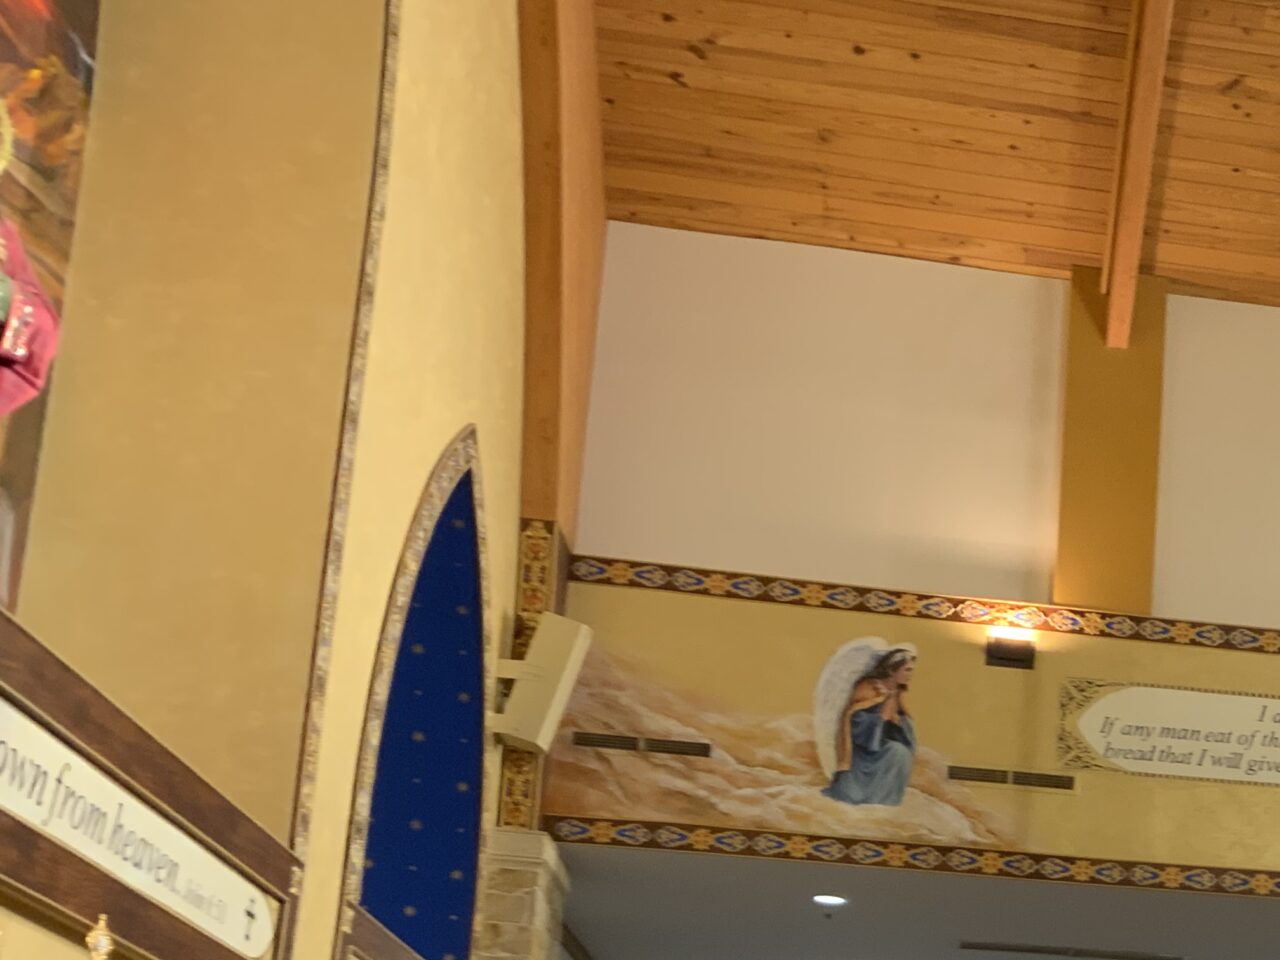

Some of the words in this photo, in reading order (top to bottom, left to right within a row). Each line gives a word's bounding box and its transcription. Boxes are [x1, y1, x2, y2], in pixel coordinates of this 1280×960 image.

[1257, 705, 1268, 722] I
[1099, 716, 1120, 738] If
[1119, 723, 1156, 741] any
[1158, 726, 1201, 742] man
[1204, 730, 1233, 744] eat
[1236, 730, 1260, 750] of
[1102, 742, 1157, 762] bread
[1158, 745, 1194, 765] that
[1196, 749, 1208, 766] I
[1210, 752, 1244, 769] will
[41, 763, 107, 845] from
